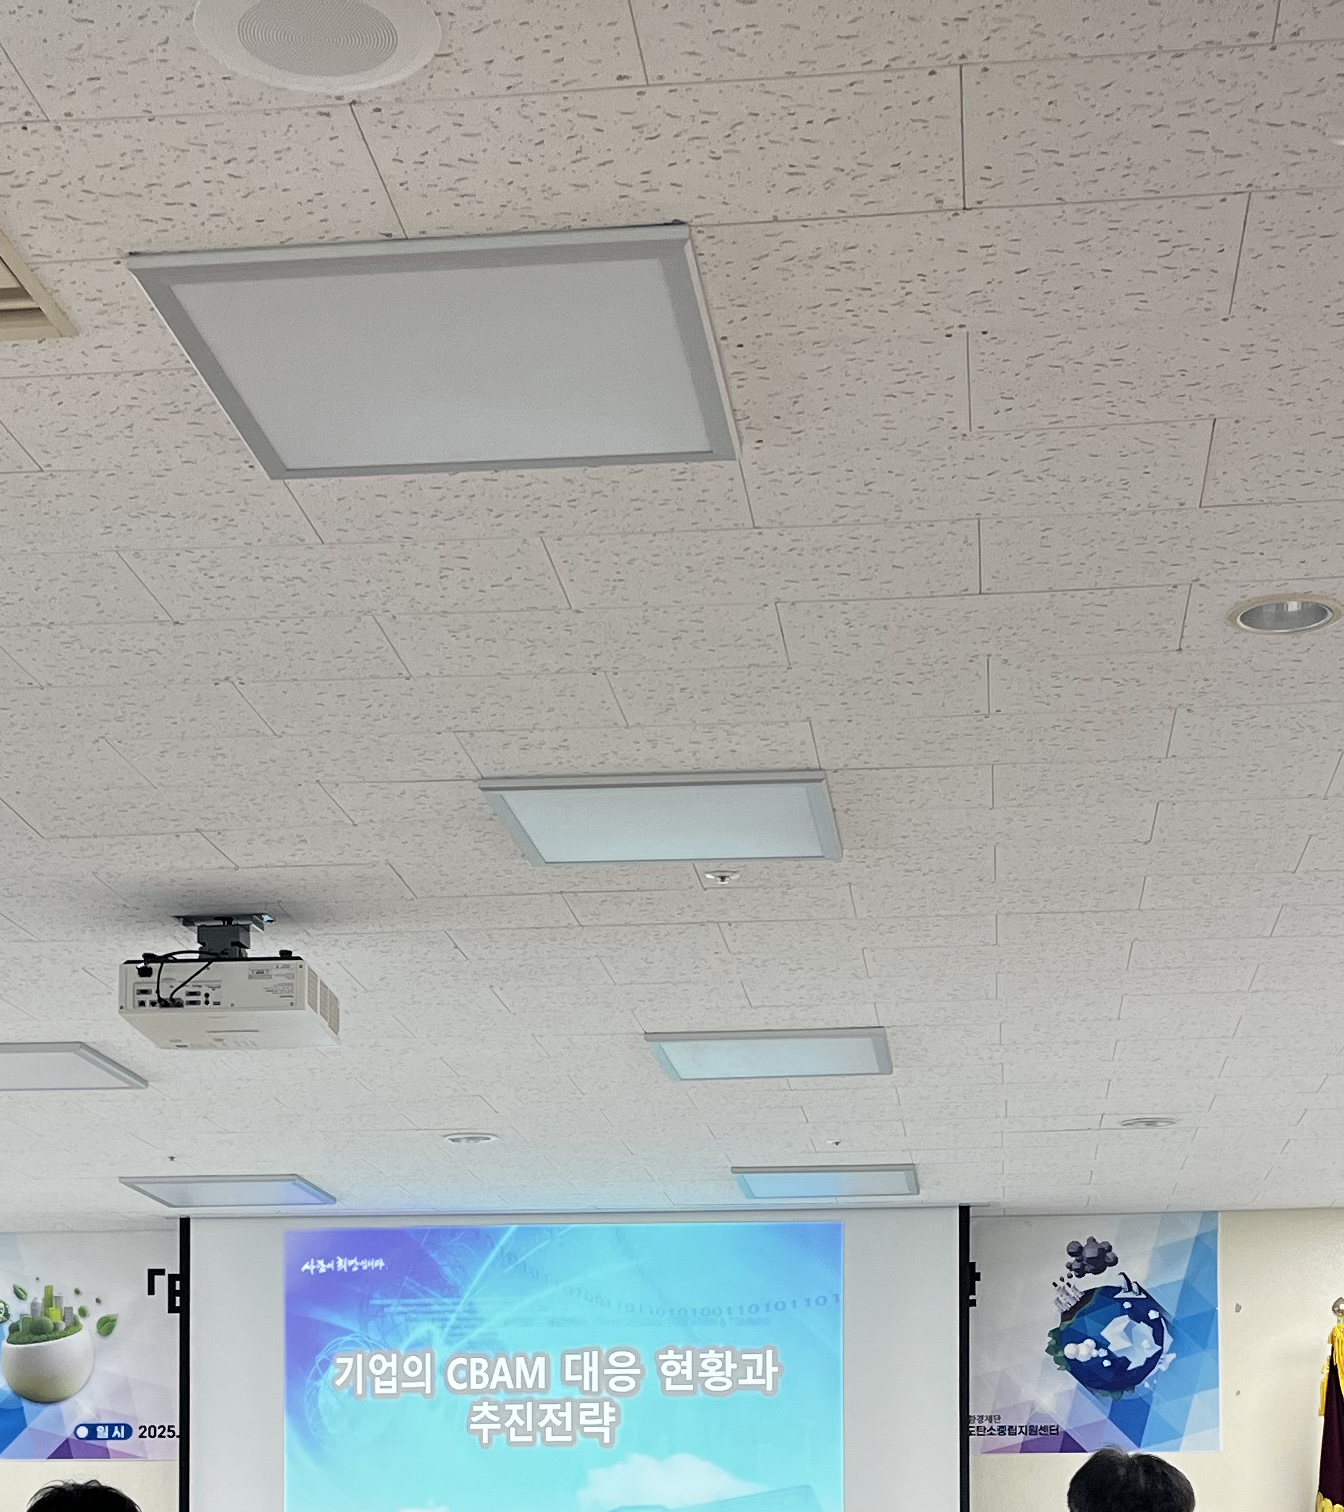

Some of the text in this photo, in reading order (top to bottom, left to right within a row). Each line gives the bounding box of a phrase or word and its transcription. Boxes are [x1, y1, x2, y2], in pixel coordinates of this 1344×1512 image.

[334, 1349, 780, 1395] 기업의 CBAM 대응 현황과
[469, 1401, 617, 1445] 추진전략
